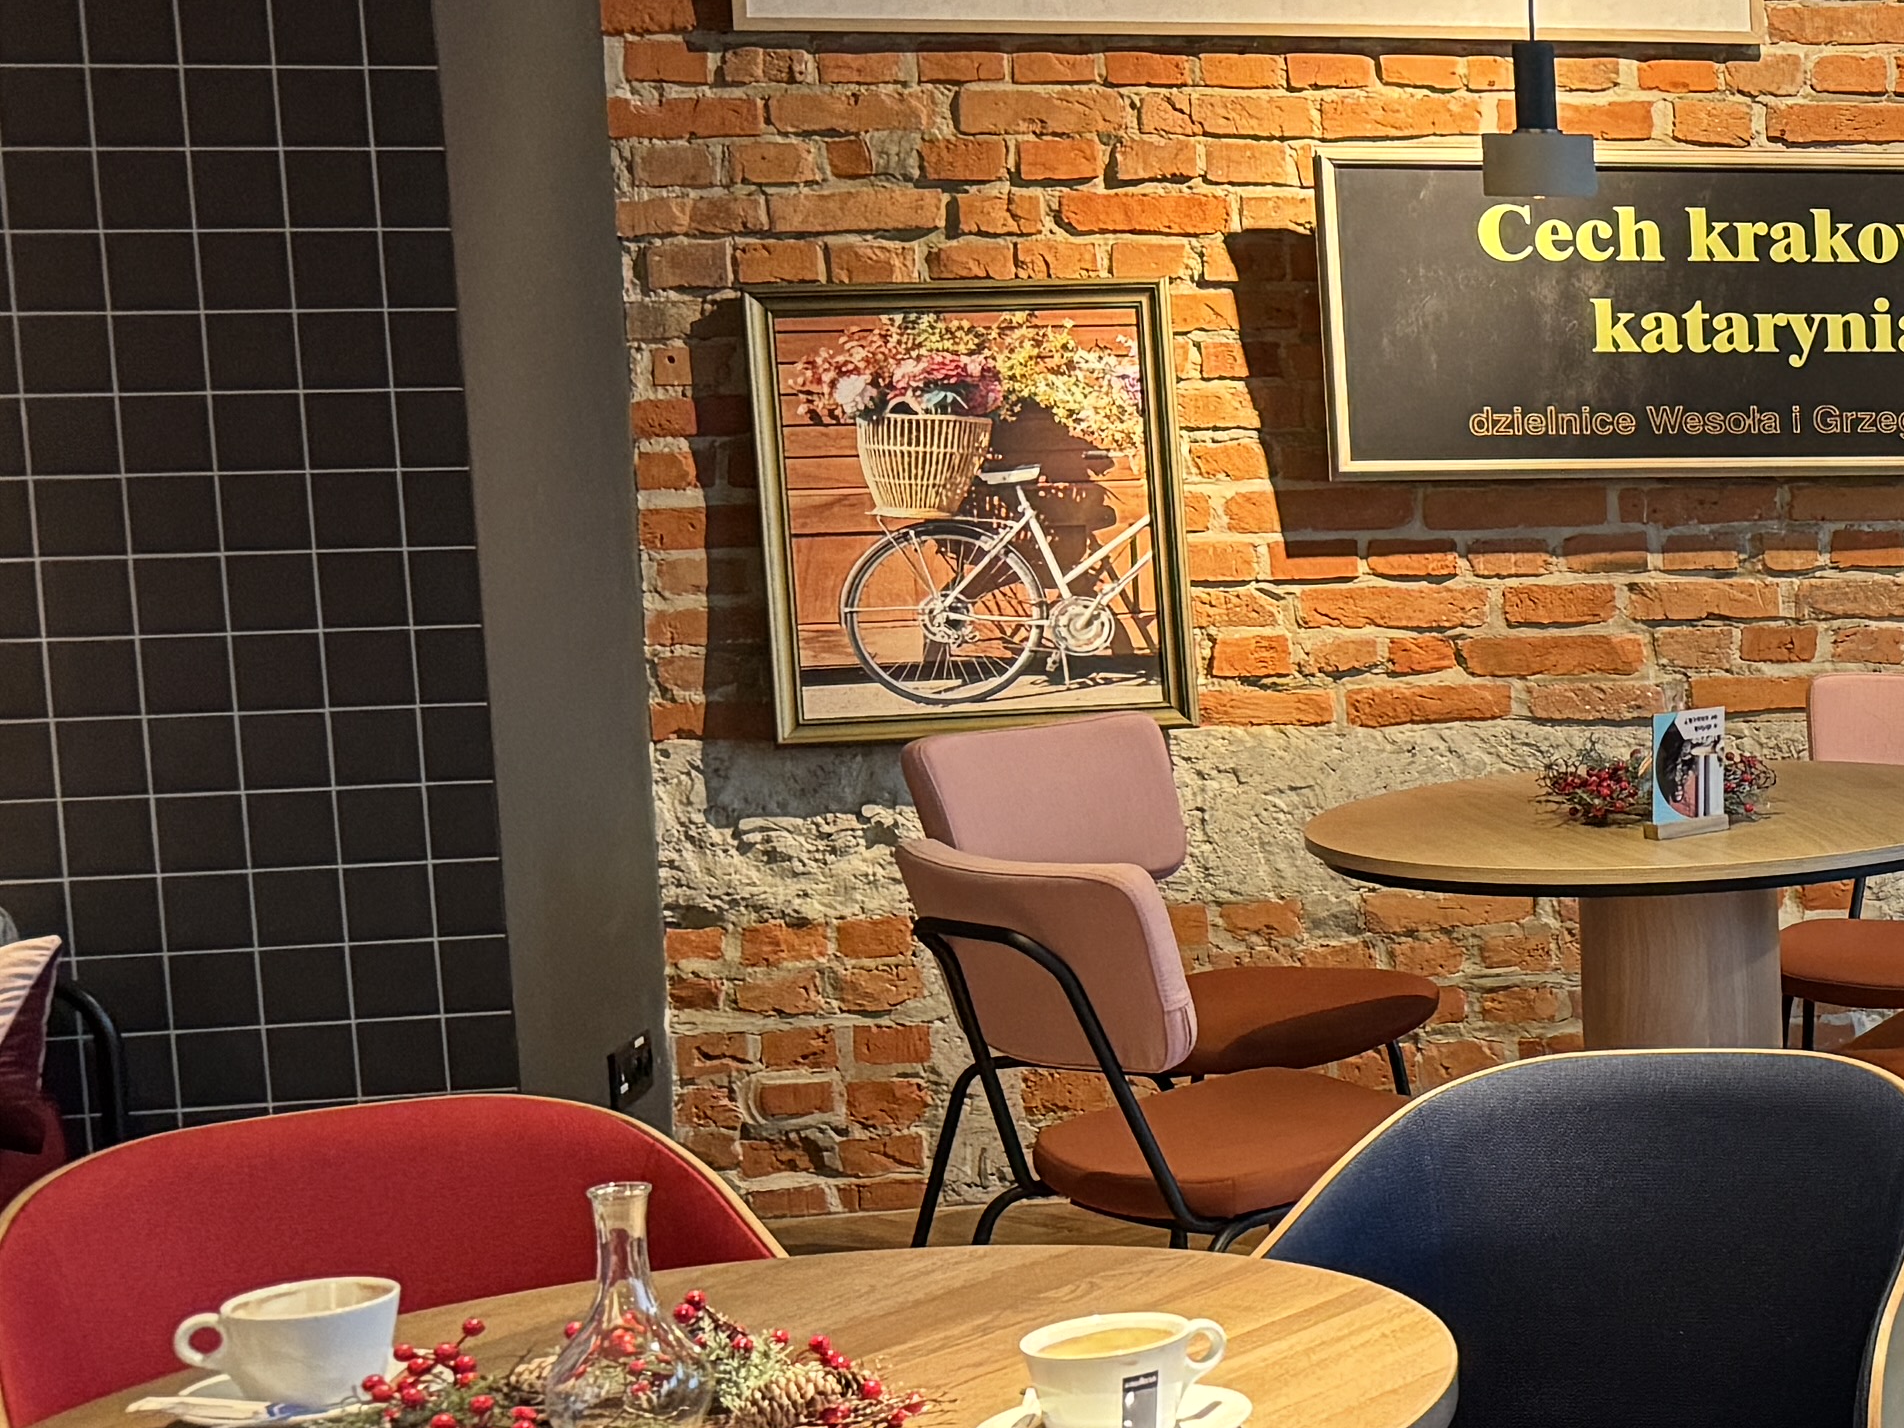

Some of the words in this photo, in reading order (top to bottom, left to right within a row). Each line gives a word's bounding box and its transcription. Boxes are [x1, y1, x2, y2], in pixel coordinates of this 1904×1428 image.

[1476, 201, 1666, 263] Cech
[1468, 404, 1637, 437] dzielnice
[1646, 404, 1781, 437] Wesoła
[1790, 404, 1801, 435] i
